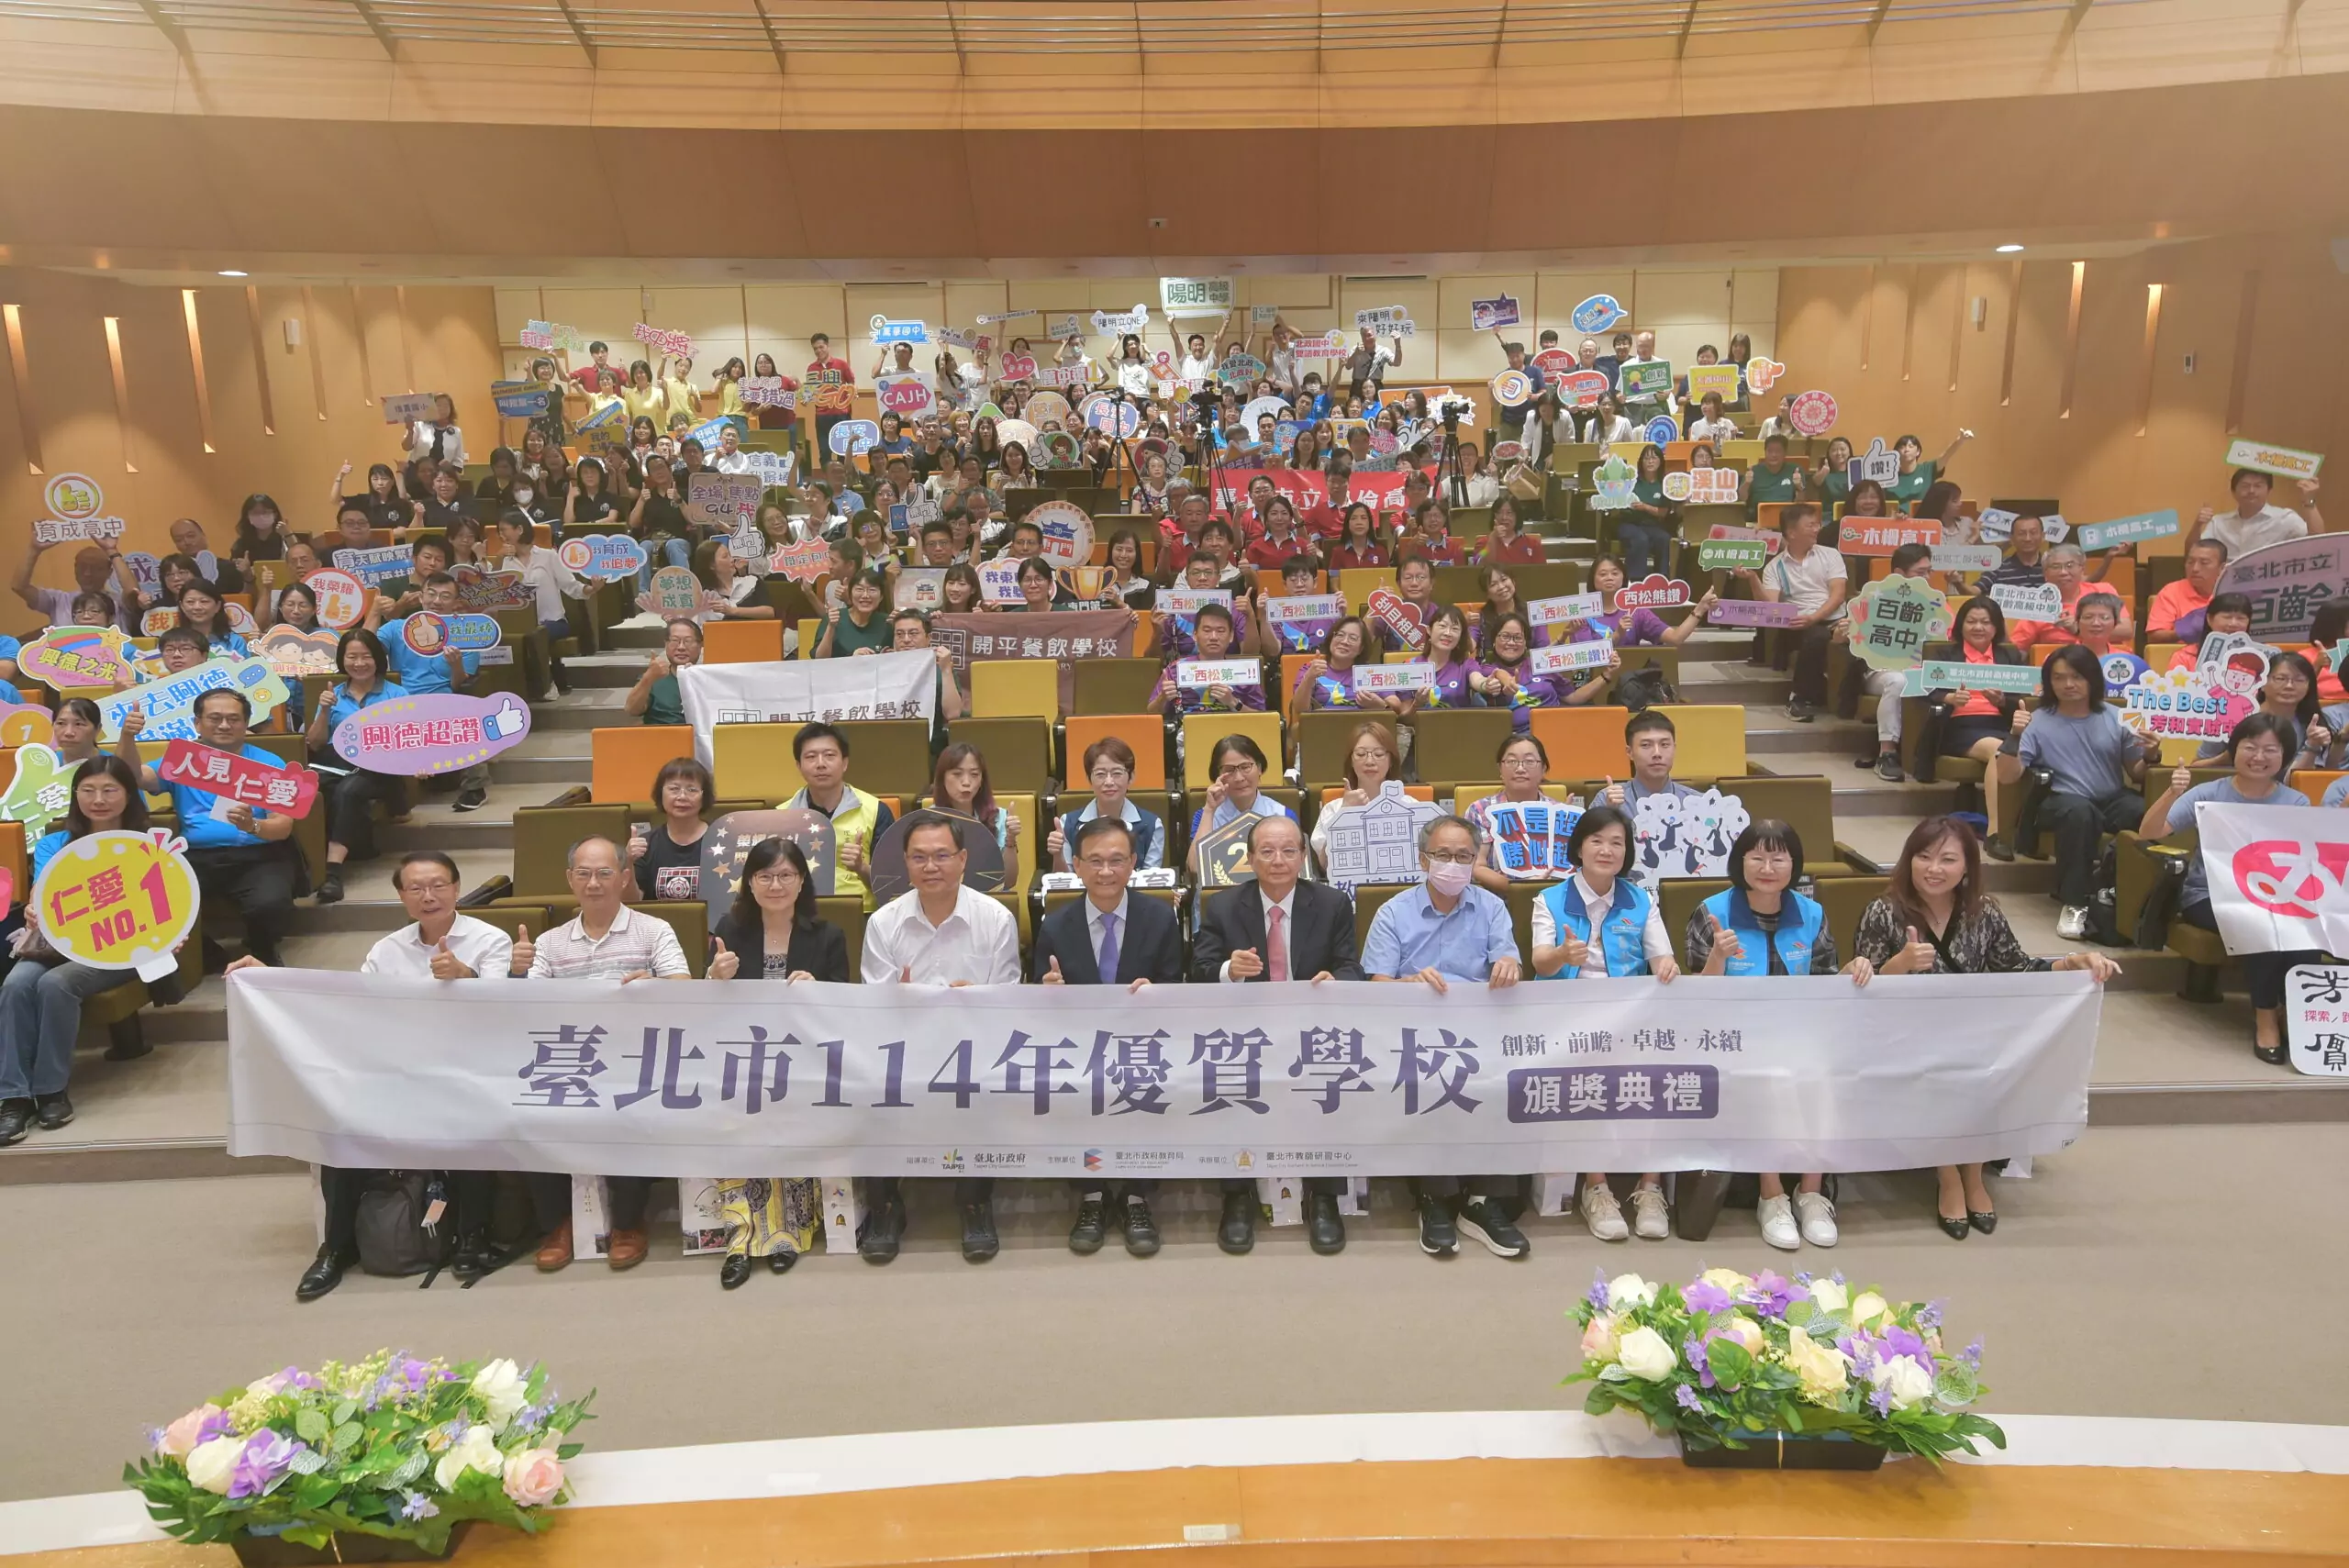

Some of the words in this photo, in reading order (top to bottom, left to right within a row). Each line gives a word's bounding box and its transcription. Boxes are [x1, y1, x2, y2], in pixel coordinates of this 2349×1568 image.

[1167, 283, 1206, 304] 陽明
[884, 388, 928, 406] CAJH
[37, 519, 123, 540] 育成高中
[1863, 526, 1939, 548] 木柵高工
[985, 571, 1019, 584] 我東
[2232, 553, 2332, 584] 臺北市立
[1624, 587, 1681, 606] 西松熊讚
[1281, 602, 1339, 617] 西松熊讚!!
[1543, 602, 1600, 620] 西松第一!!
[1876, 597, 1926, 625] 百齡
[1375, 596, 1425, 645] 刮目相看
[972, 635, 1119, 659] 開平餐飲學校
[1869, 623, 1919, 650] 高中
[39, 647, 119, 681] 興德之光
[1548, 648, 1611, 669] 西松熊讚!!
[1195, 667, 1257, 683] 西松第一!!
[1370, 672, 1433, 688] 西松第一!!
[2129, 688, 2172, 713] The
[2176, 692, 2228, 716] Best
[361, 717, 482, 752] 興德超讚
[50, 865, 127, 928] 仁愛
[512, 1023, 1484, 1117] 臺北市114年優質學校
[1523, 1072, 1703, 1114] 頒獎典禮
[941, 1162, 965, 1171] TAIPEI
[974, 1151, 1027, 1164] 臺北市政府
[1115, 1151, 1185, 1161] 臺北市政府教育局
[1265, 1151, 1353, 1162] 臺北市教師研習中心
